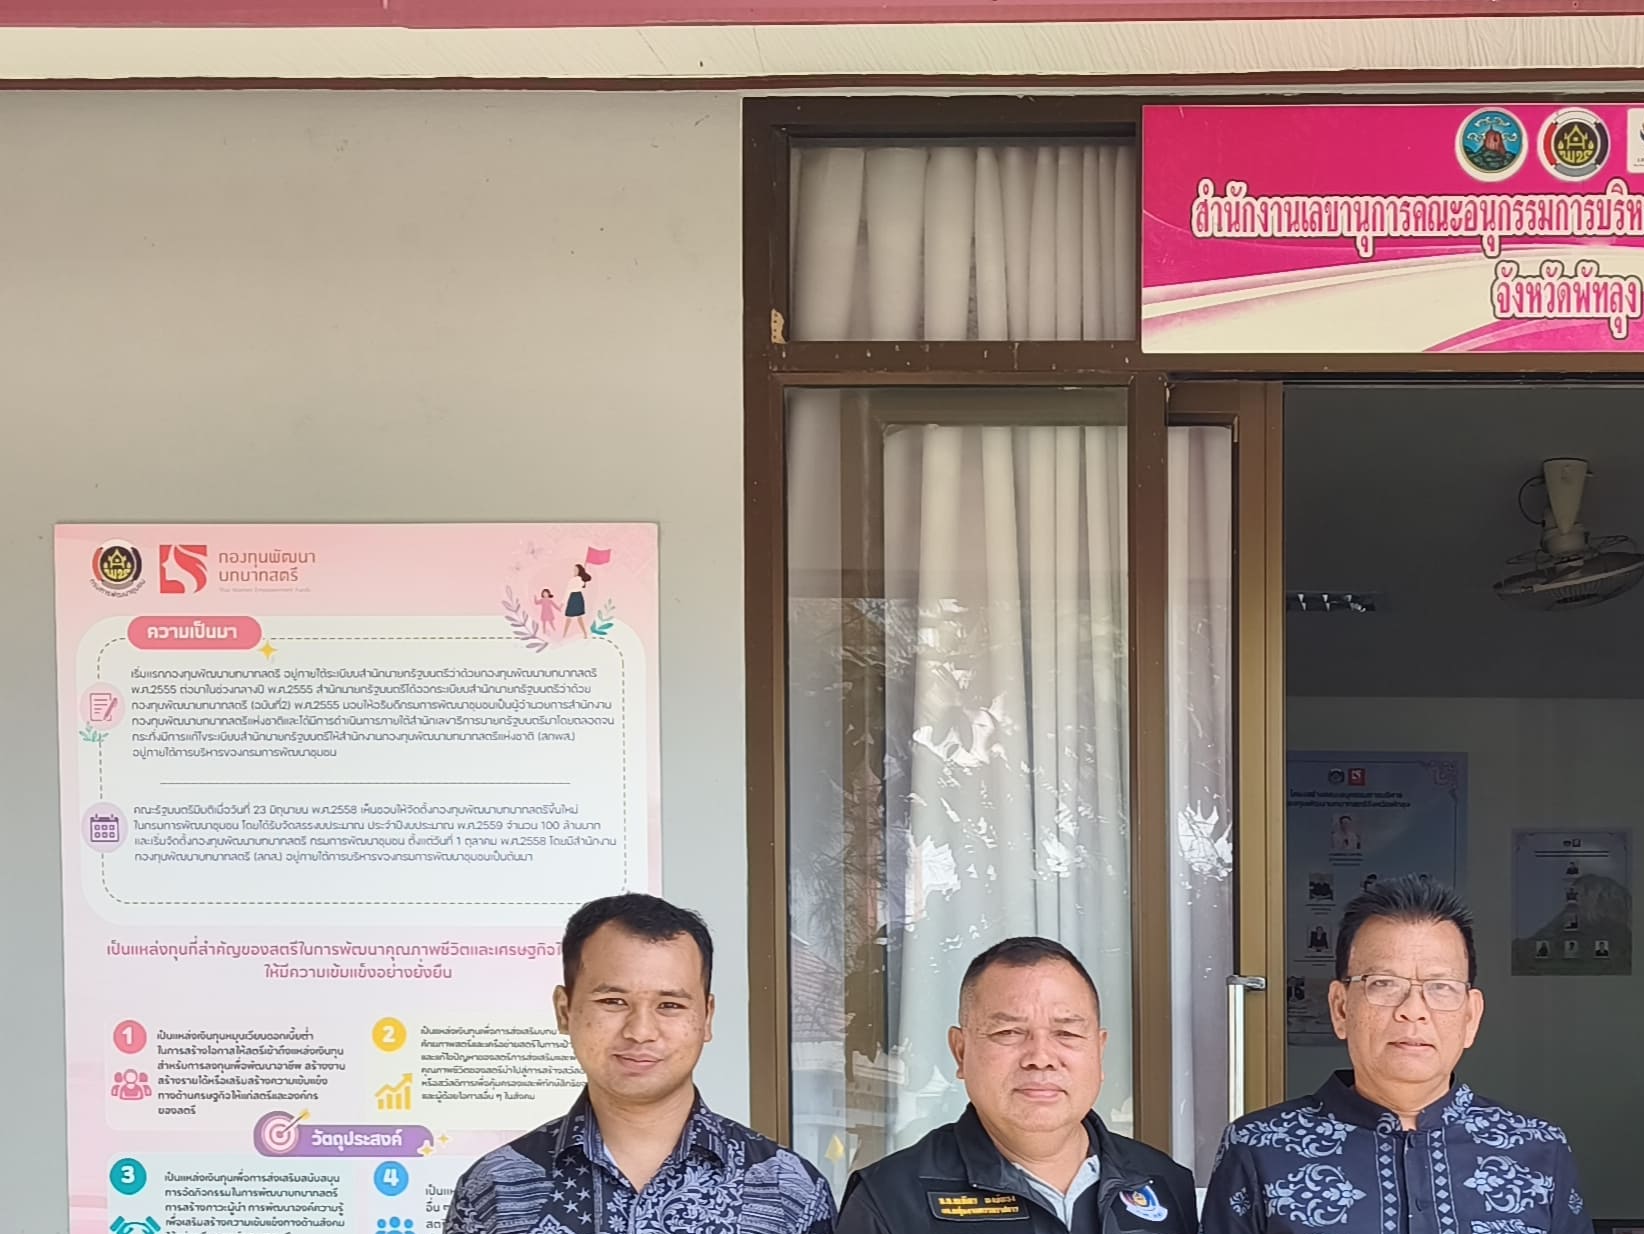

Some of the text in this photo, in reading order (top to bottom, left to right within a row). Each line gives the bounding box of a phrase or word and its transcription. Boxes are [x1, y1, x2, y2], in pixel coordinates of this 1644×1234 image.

[1495, 264, 1639, 336] จังหวัดพัทลุง
[218, 549, 316, 567] กองทุนพัฒนา
[218, 567, 299, 582] บทบาทสตรี
[147, 621, 237, 640] ความเป็นมา
[254, 805, 266, 814] 23
[541, 821, 560, 830] 100
[456, 837, 461, 846] 1
[265, 960, 452, 980] ให้มีความเข้มแข็งอย่างยั่งยืน
[122, 1027, 133, 1045] 1
[383, 1025, 395, 1043] 2
[311, 1127, 403, 1152] วัตถุประสงค์
[121, 1166, 135, 1183] 3
[383, 1168, 399, 1186] 4
